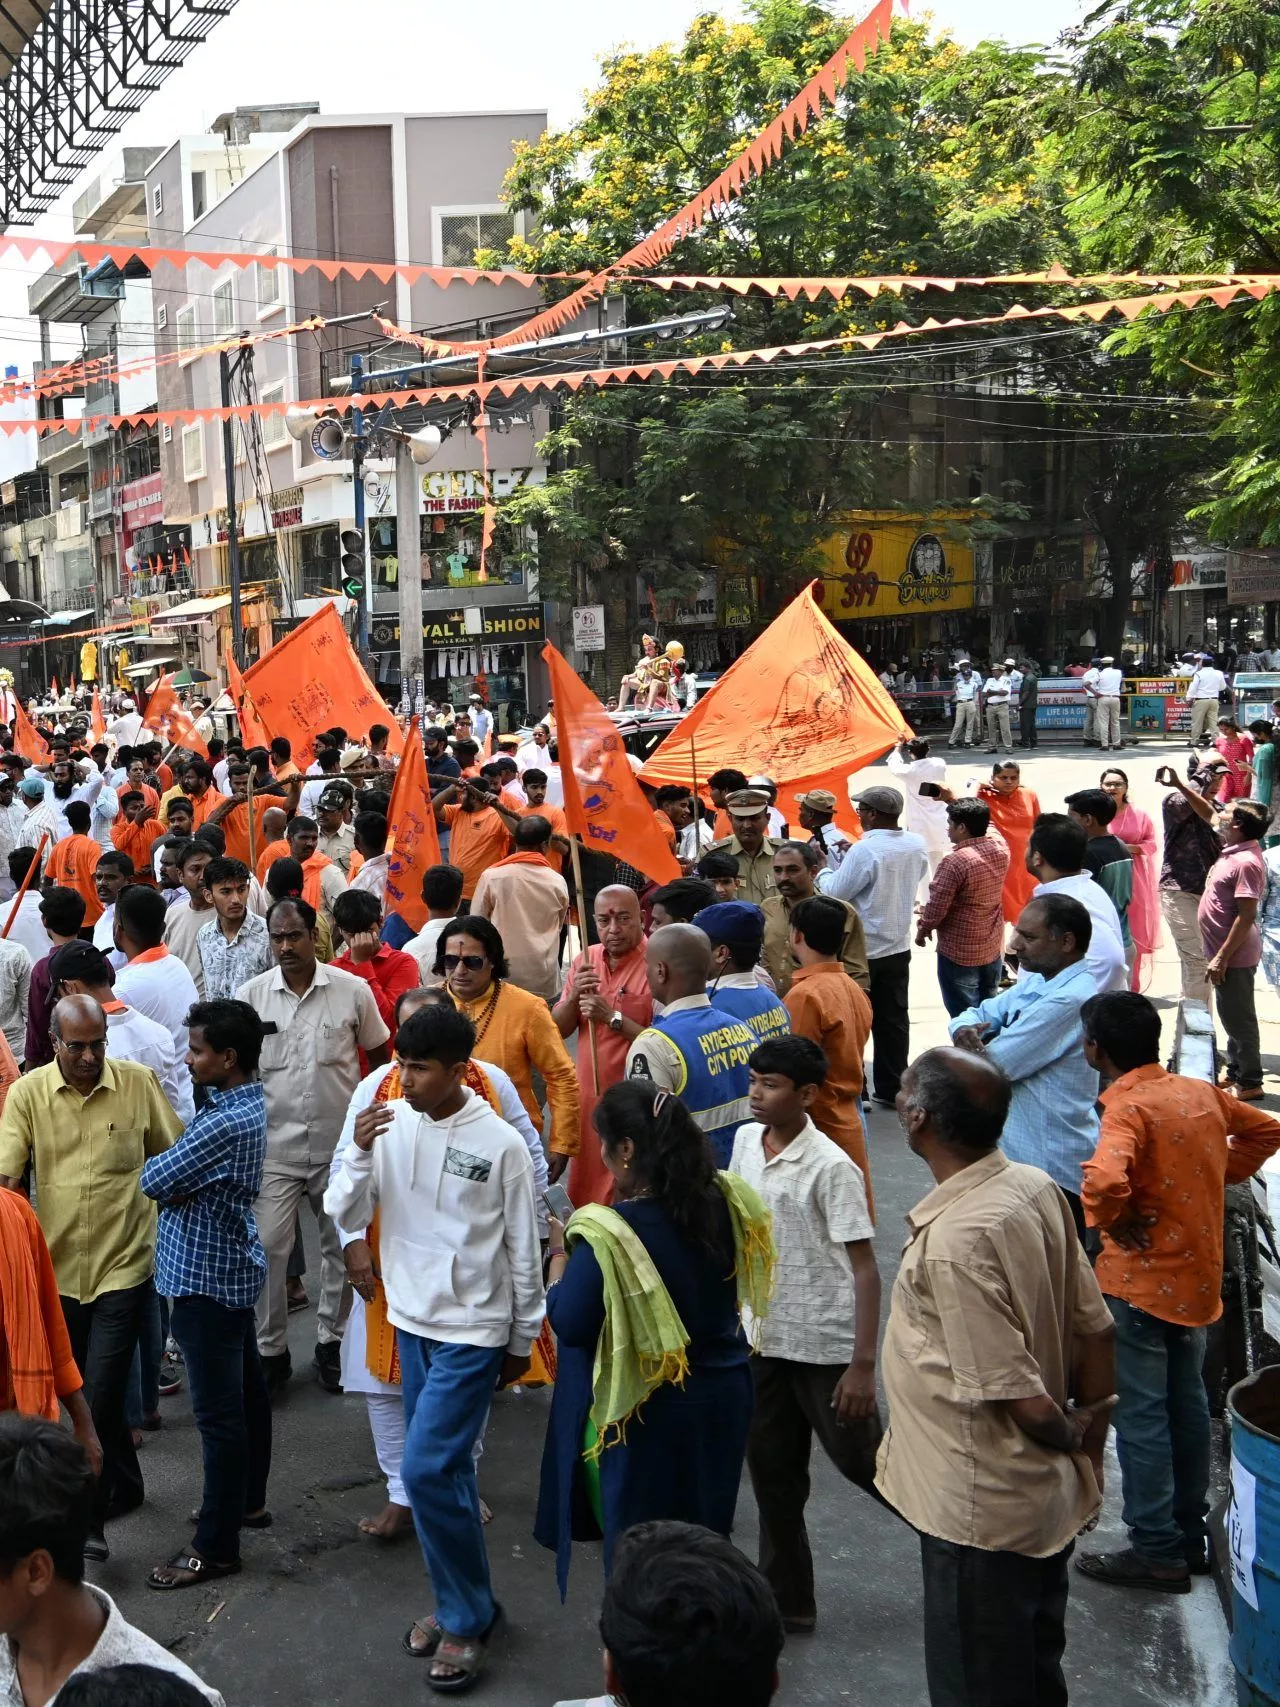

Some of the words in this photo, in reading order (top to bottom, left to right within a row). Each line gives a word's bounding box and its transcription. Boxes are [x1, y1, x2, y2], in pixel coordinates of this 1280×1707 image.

[423, 499, 445, 512] THE
[448, 498, 486, 511] FASHI
[846, 533, 873, 570] 69
[841, 571, 879, 608] 399
[394, 623, 454, 640] RYAL
[460, 617, 540, 635] FSHION
[707, 1053, 730, 1076] CITY
[730, 1043, 759, 1069] POLIC
